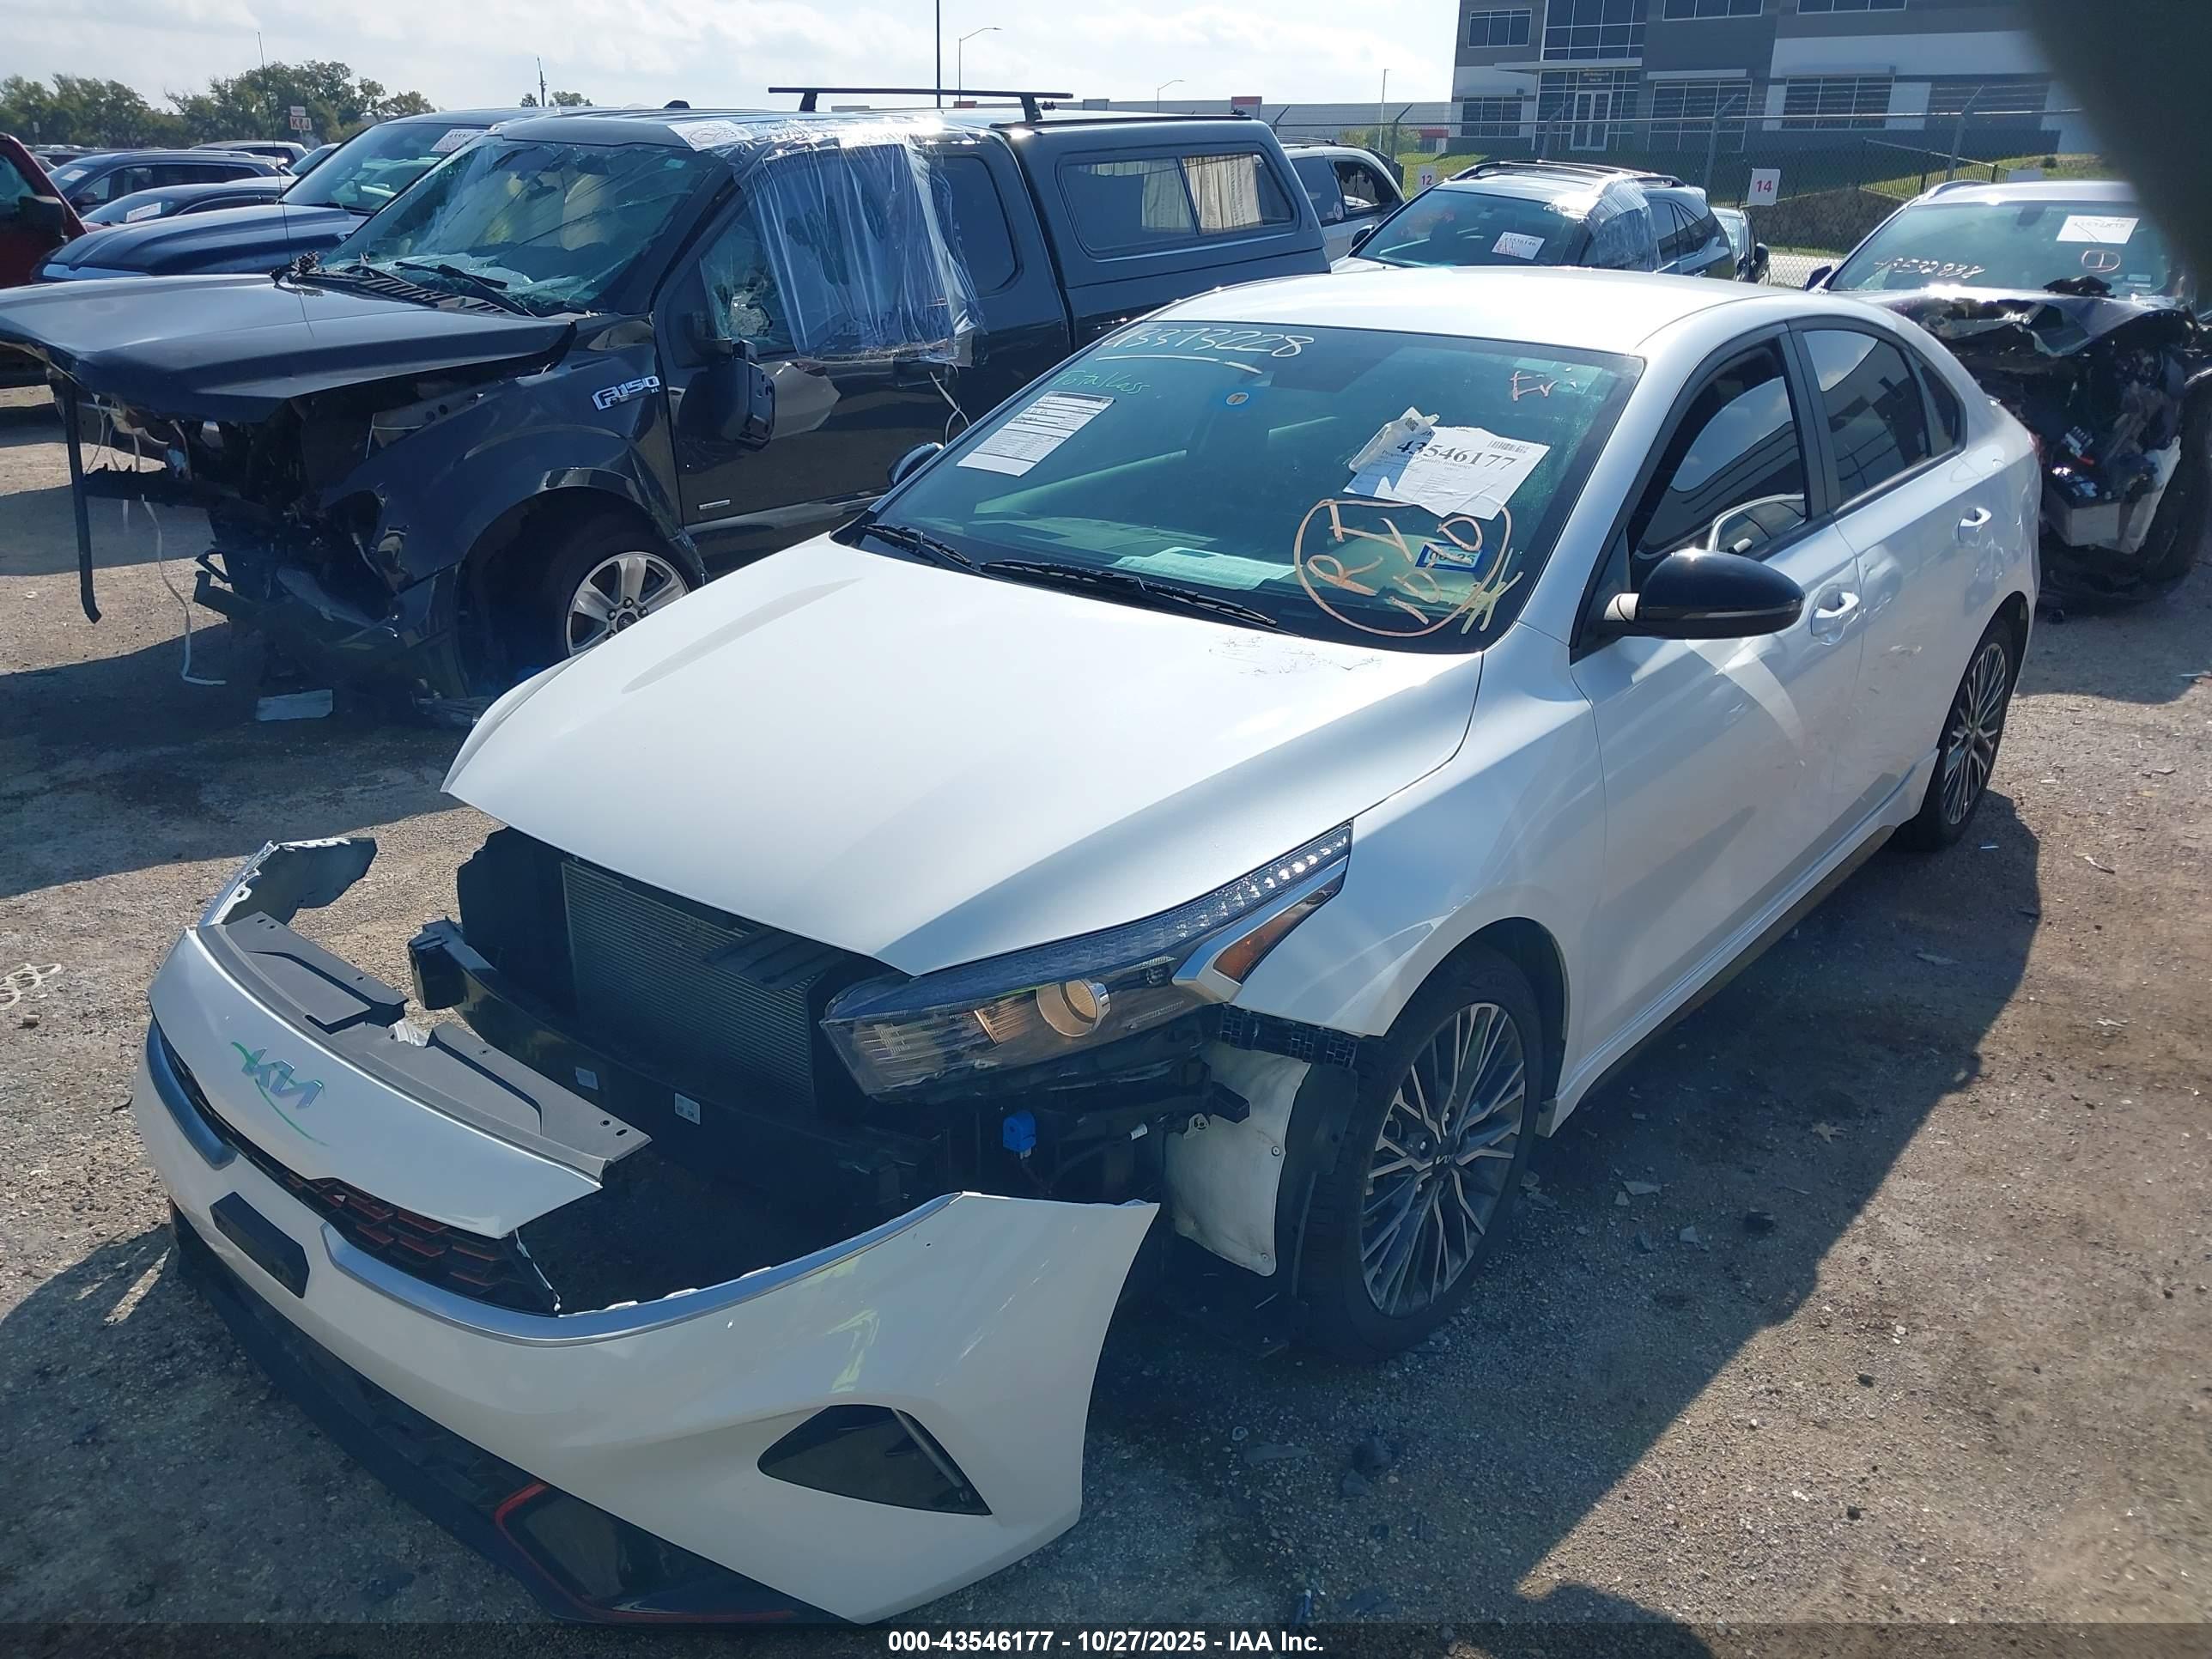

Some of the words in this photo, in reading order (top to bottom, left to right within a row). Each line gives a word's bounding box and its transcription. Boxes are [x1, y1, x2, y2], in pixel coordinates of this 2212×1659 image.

[1421, 174, 1432, 185] 12
[1757, 179, 1772, 193] 14
[1396, 440, 1518, 471] 43546177
